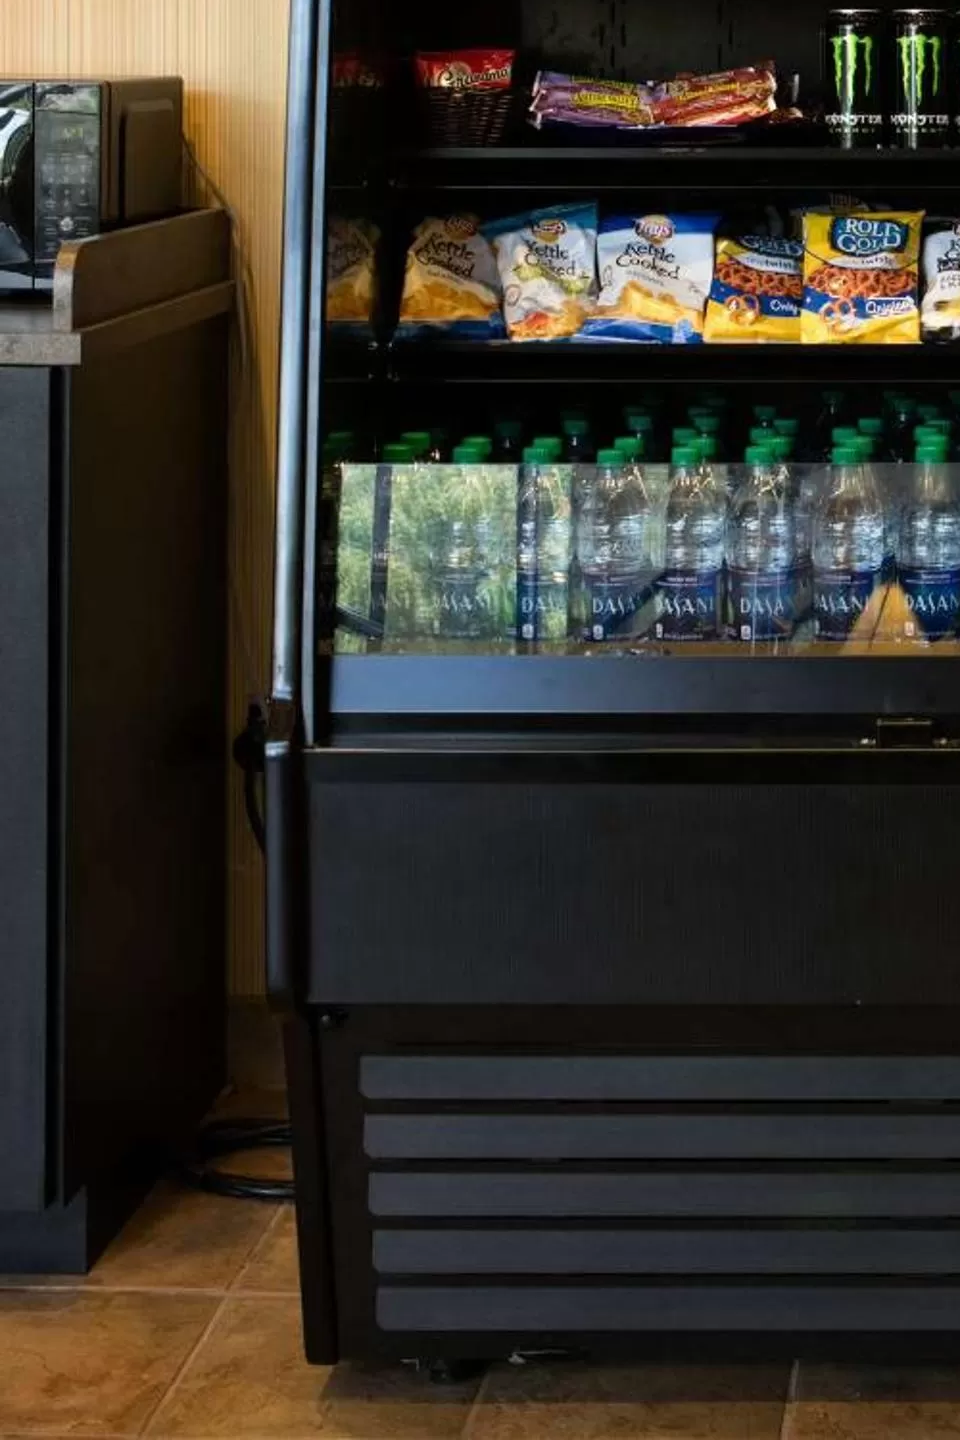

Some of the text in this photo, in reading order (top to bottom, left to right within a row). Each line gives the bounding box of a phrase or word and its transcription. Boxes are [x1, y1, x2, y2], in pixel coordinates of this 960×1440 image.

[836, 224, 902, 252] GOLD
[845, 217, 902, 247] ROLD
[616, 254, 680, 280] Cooked
